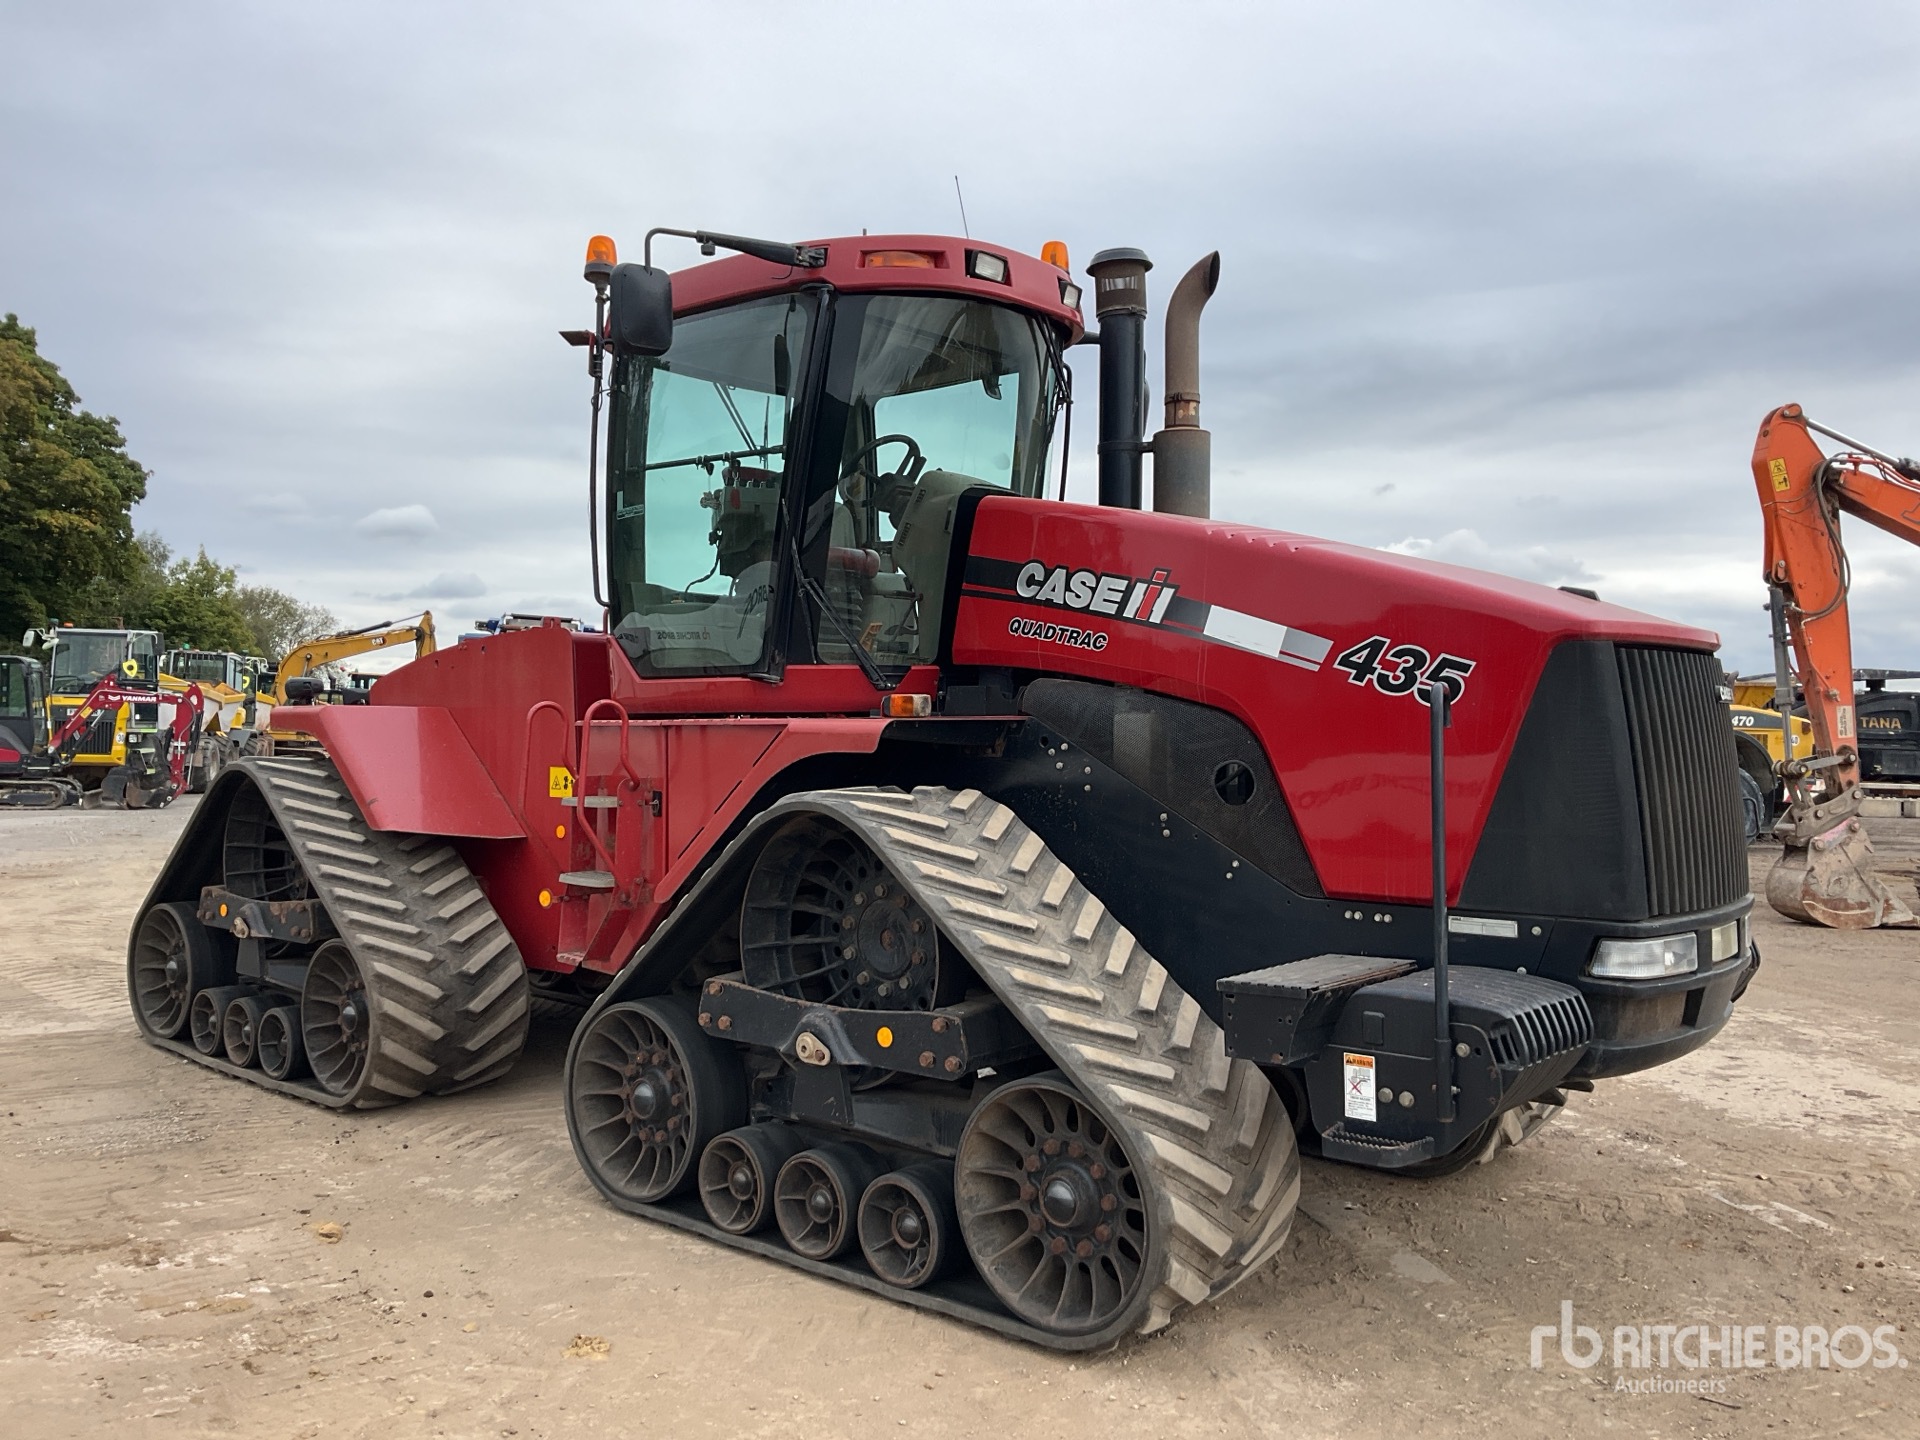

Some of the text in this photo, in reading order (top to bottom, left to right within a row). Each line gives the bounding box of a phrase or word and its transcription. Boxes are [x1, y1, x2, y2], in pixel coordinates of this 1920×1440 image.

[1016, 562, 1128, 614] CASE
[1008, 617, 1109, 651] QUADTRAC
[1333, 635, 1477, 708] 435
[1731, 715, 1754, 727] 470
[1860, 716, 1902, 729] TANA
